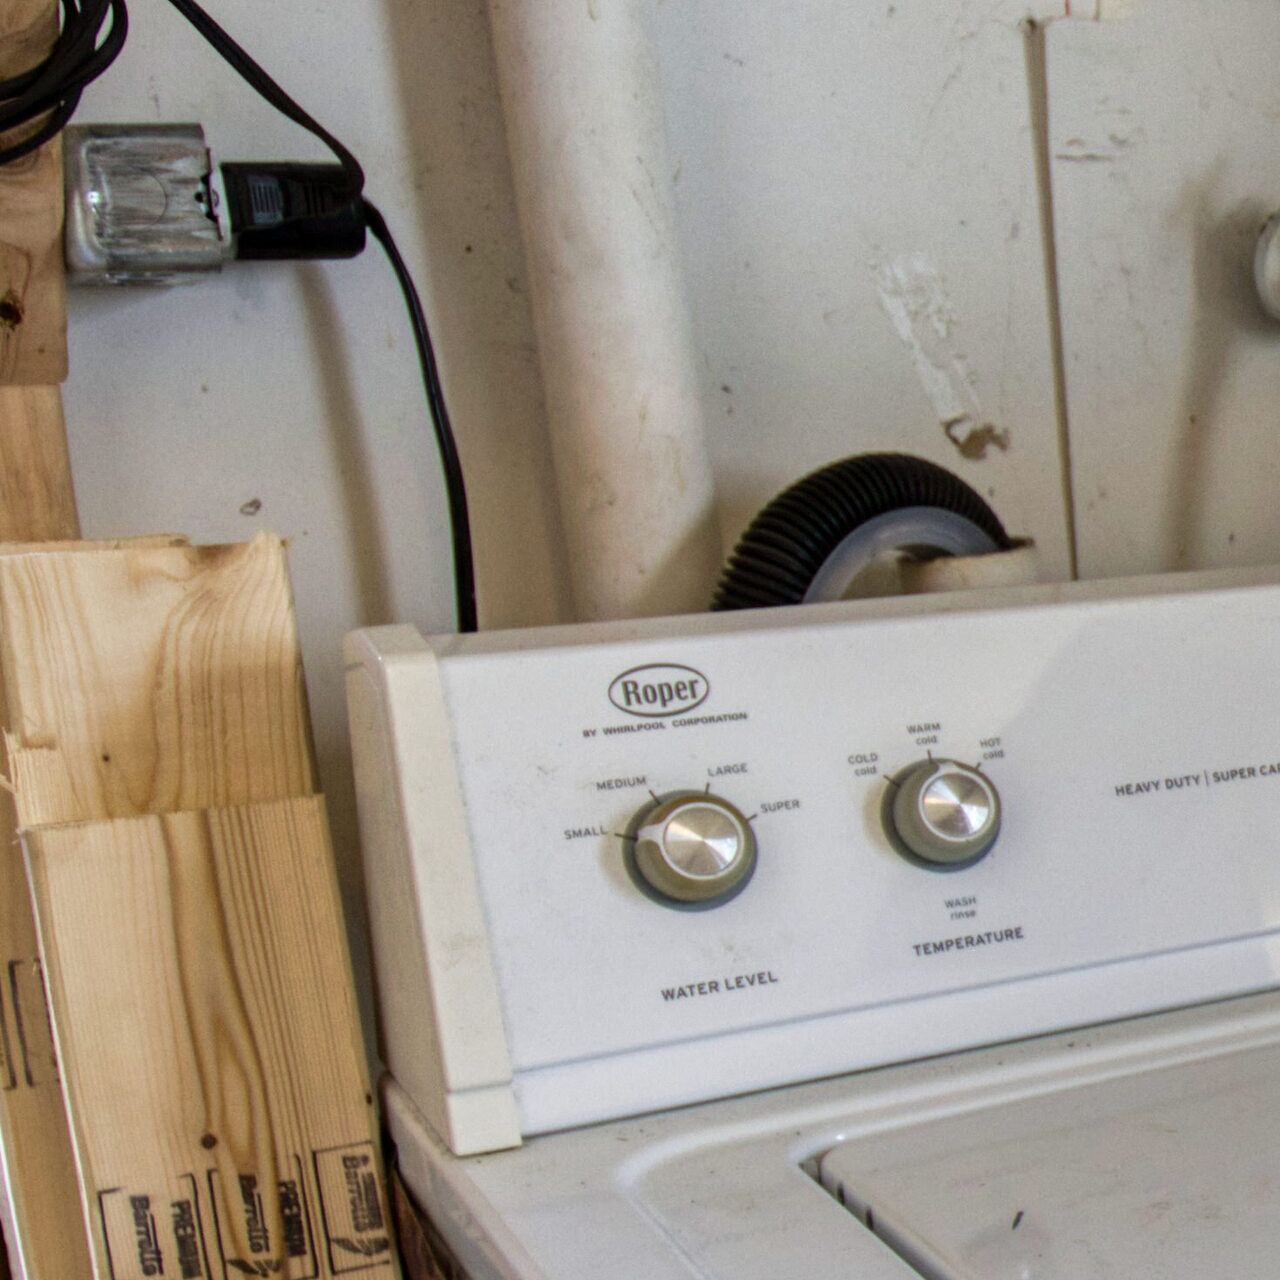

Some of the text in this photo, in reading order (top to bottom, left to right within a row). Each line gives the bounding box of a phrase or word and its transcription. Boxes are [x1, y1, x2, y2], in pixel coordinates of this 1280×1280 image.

[621, 678, 700, 708] Roper
[582, 711, 748, 738] BY WHIRLPOOL CORPORATION
[906, 722, 941, 734] WARM
[916, 735, 938, 746] cold
[980, 737, 1001, 748] HOT
[847, 752, 879, 765] COLD
[982, 749, 1005, 760] cold
[707, 762, 748, 777] LARGE
[854, 766, 878, 777] cold
[596, 775, 647, 791] MEDIUM
[1114, 780, 1160, 797] HEAVY
[1165, 774, 1200, 790] DUTY
[1212, 767, 1256, 783] SUPER
[760, 799, 801, 814] SUPER
[564, 824, 608, 840] SMALL
[944, 895, 977, 910] WASH
[950, 909, 977, 921] rinse
[913, 926, 1024, 957] TEMPERATURE
[661, 970, 778, 1002] WATER LEVEL
